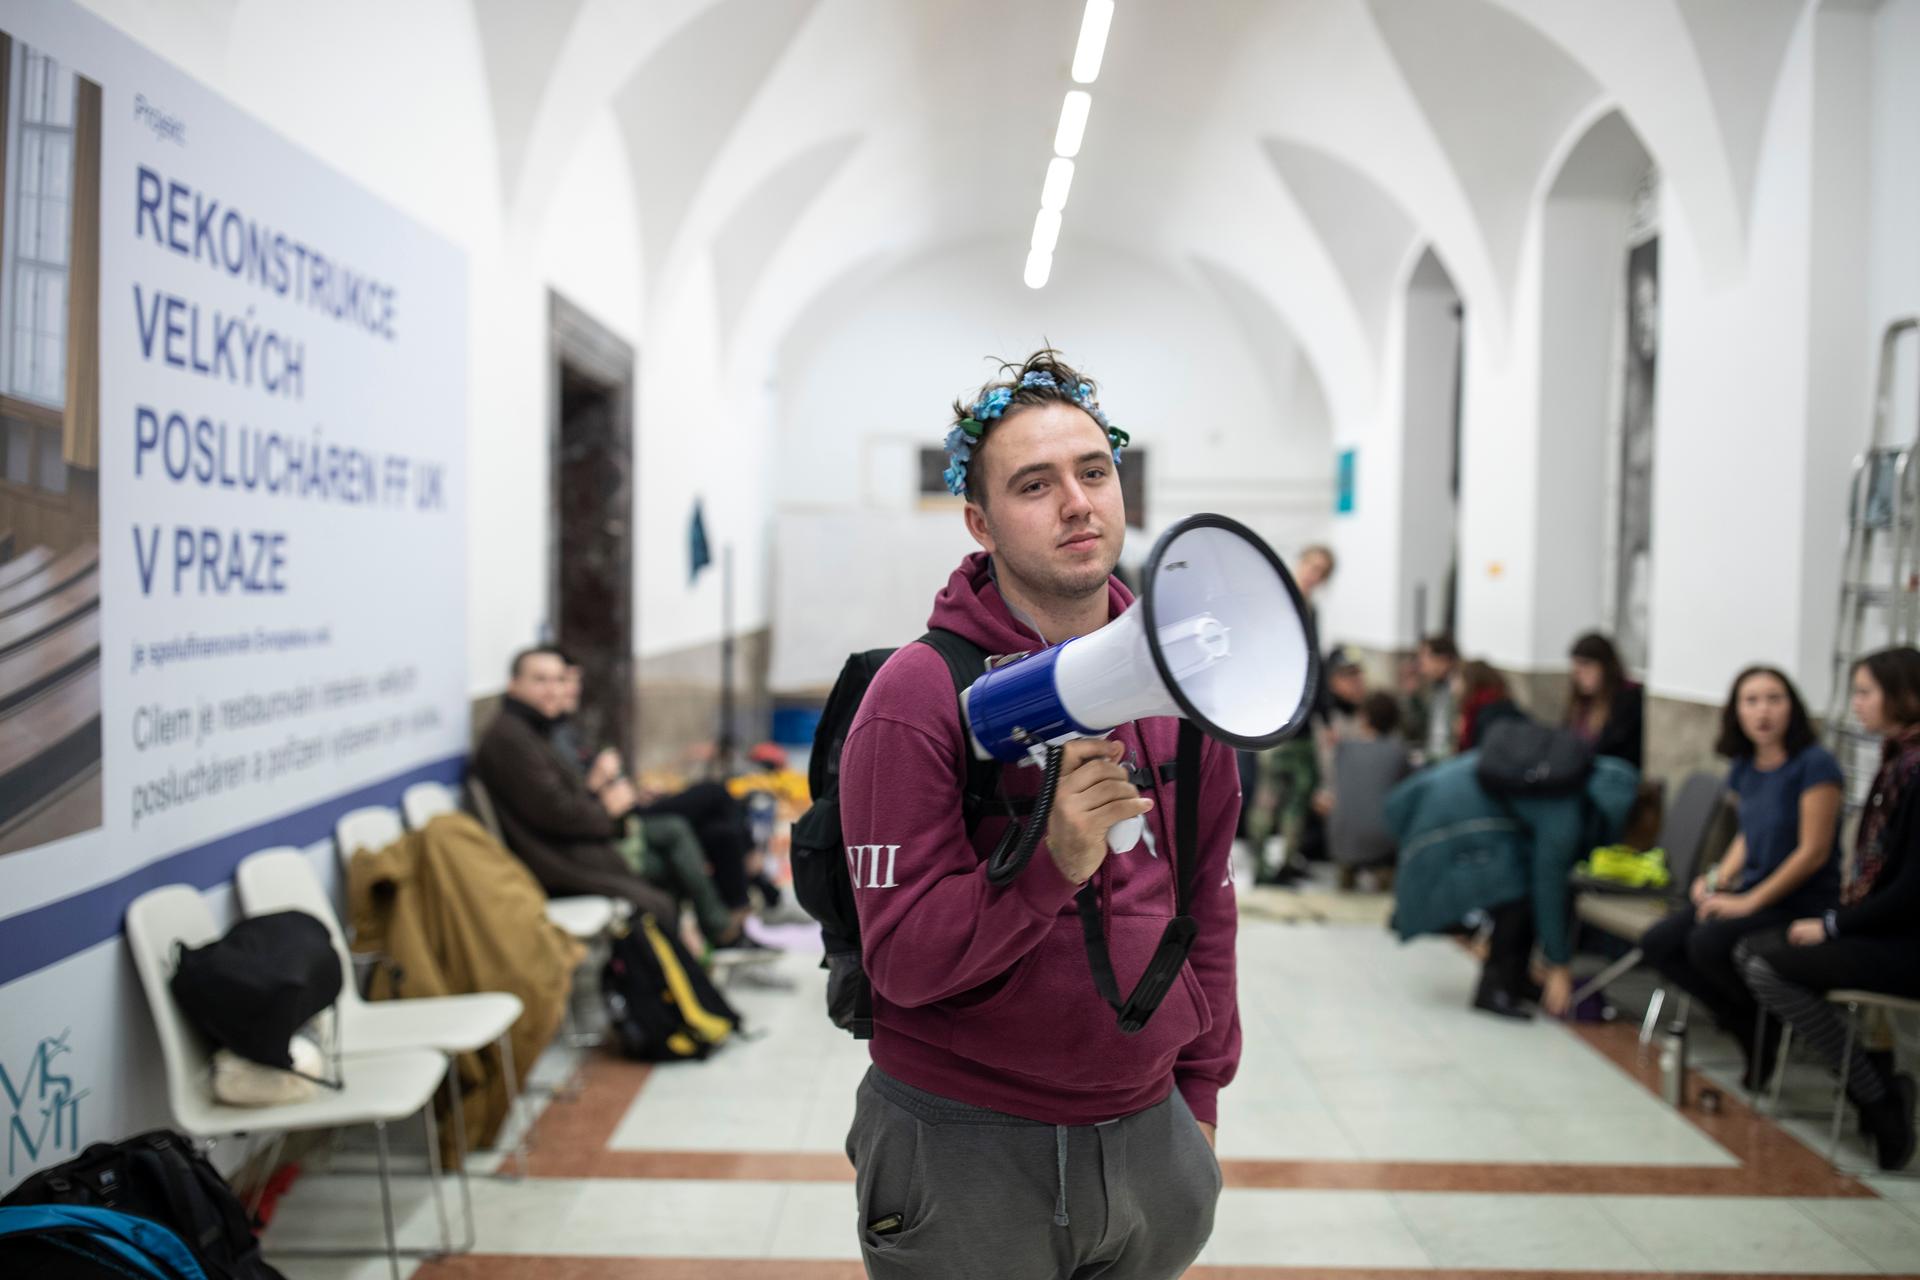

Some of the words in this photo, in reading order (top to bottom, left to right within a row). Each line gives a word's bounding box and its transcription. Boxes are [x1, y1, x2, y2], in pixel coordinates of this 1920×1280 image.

[135, 162, 398, 340] REKONSTRUKCE
[133, 281, 304, 400] VELKÝCH
[134, 402, 379, 508] POSLUCHÁREN
[384, 452, 412, 510] FF
[132, 522, 161, 597] V
[173, 526, 288, 595] PRAZE
